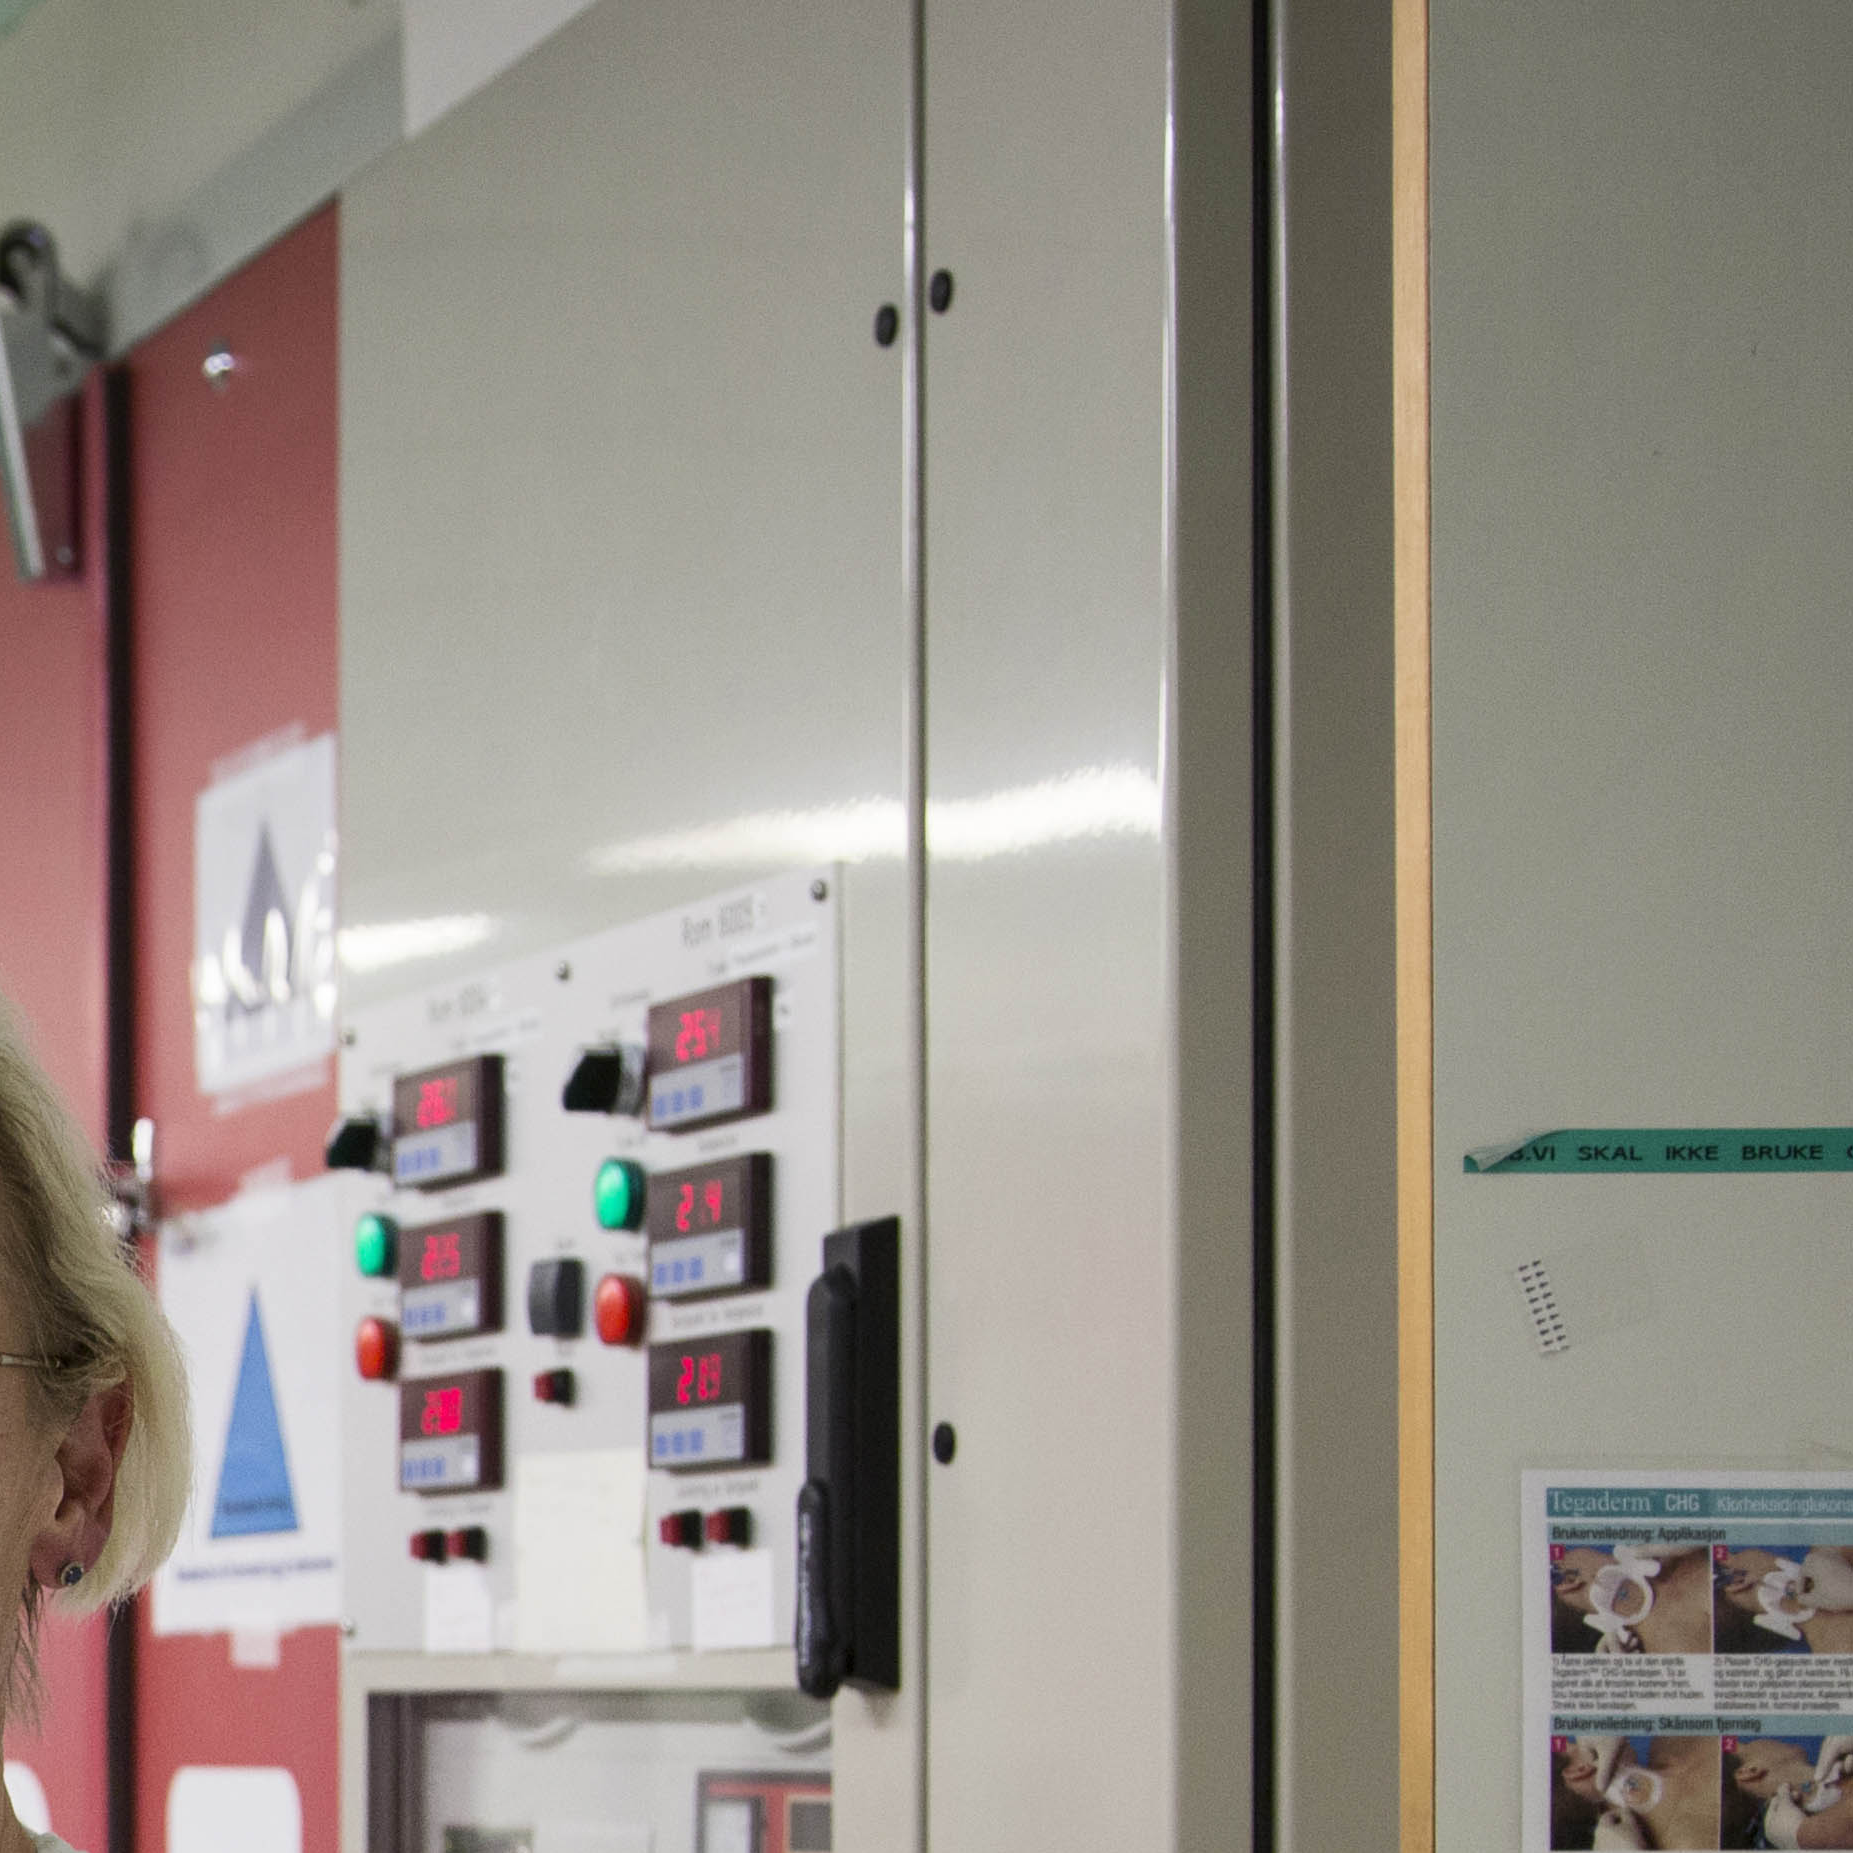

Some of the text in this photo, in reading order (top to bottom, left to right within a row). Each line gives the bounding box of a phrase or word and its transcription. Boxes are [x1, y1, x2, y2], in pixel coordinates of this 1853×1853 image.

[1578, 1146, 1642, 1160] SKAL
[1666, 1145, 1718, 1160] IKKE
[1742, 1145, 1823, 1160] BRUKE
[1665, 1494, 1700, 1512] CHG
